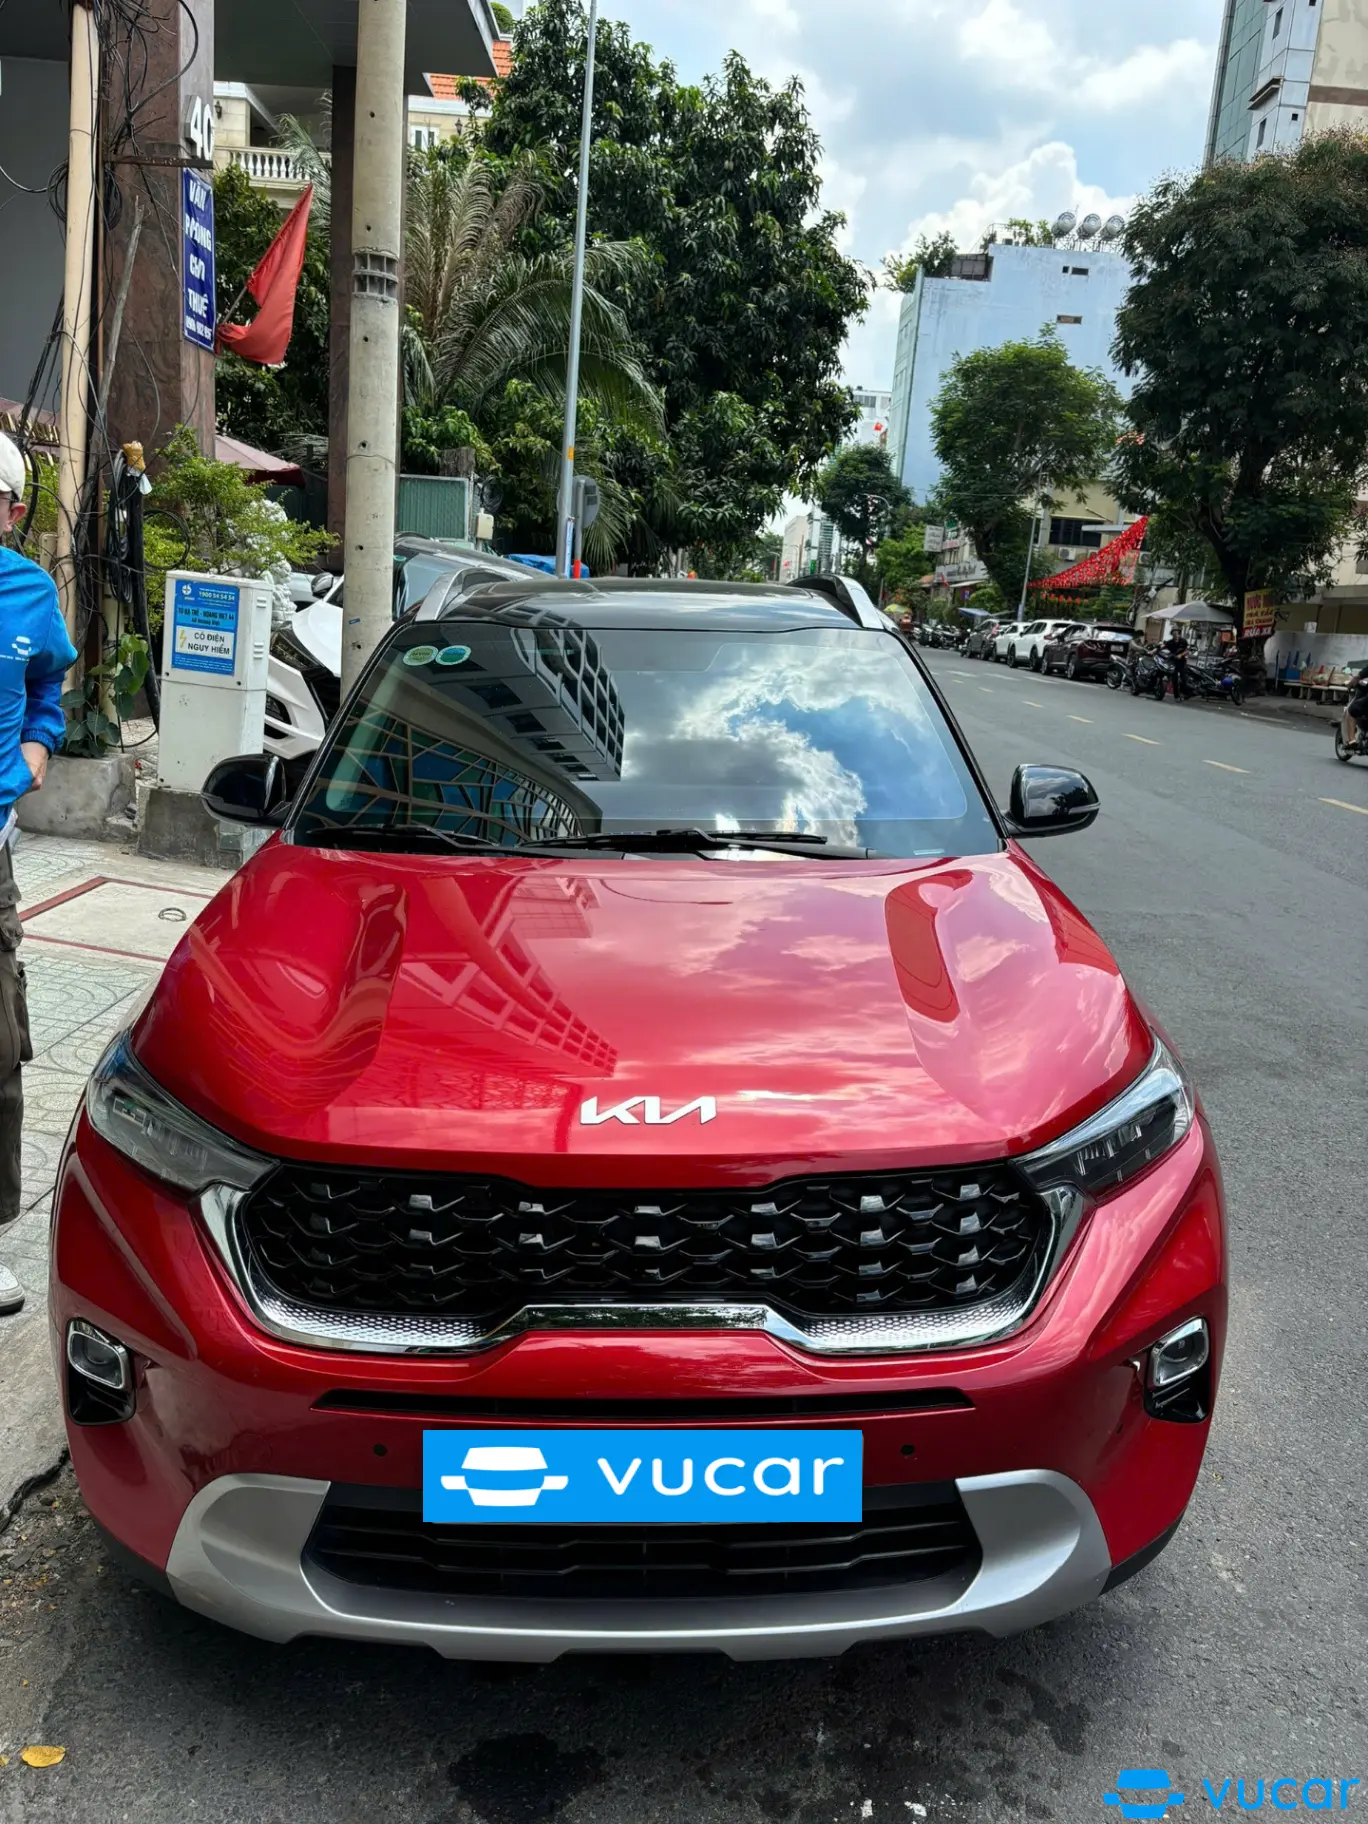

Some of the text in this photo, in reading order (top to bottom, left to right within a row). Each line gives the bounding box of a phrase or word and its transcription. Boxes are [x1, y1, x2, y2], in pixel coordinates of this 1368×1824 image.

[190, 96, 214, 160] 40
[187, 287, 209, 318] THUÊ
[187, 643, 230, 655] NGUY HIỂM
[194, 631, 225, 643] CÓ ĐIỆN
[580, 1096, 717, 1125] KIA
